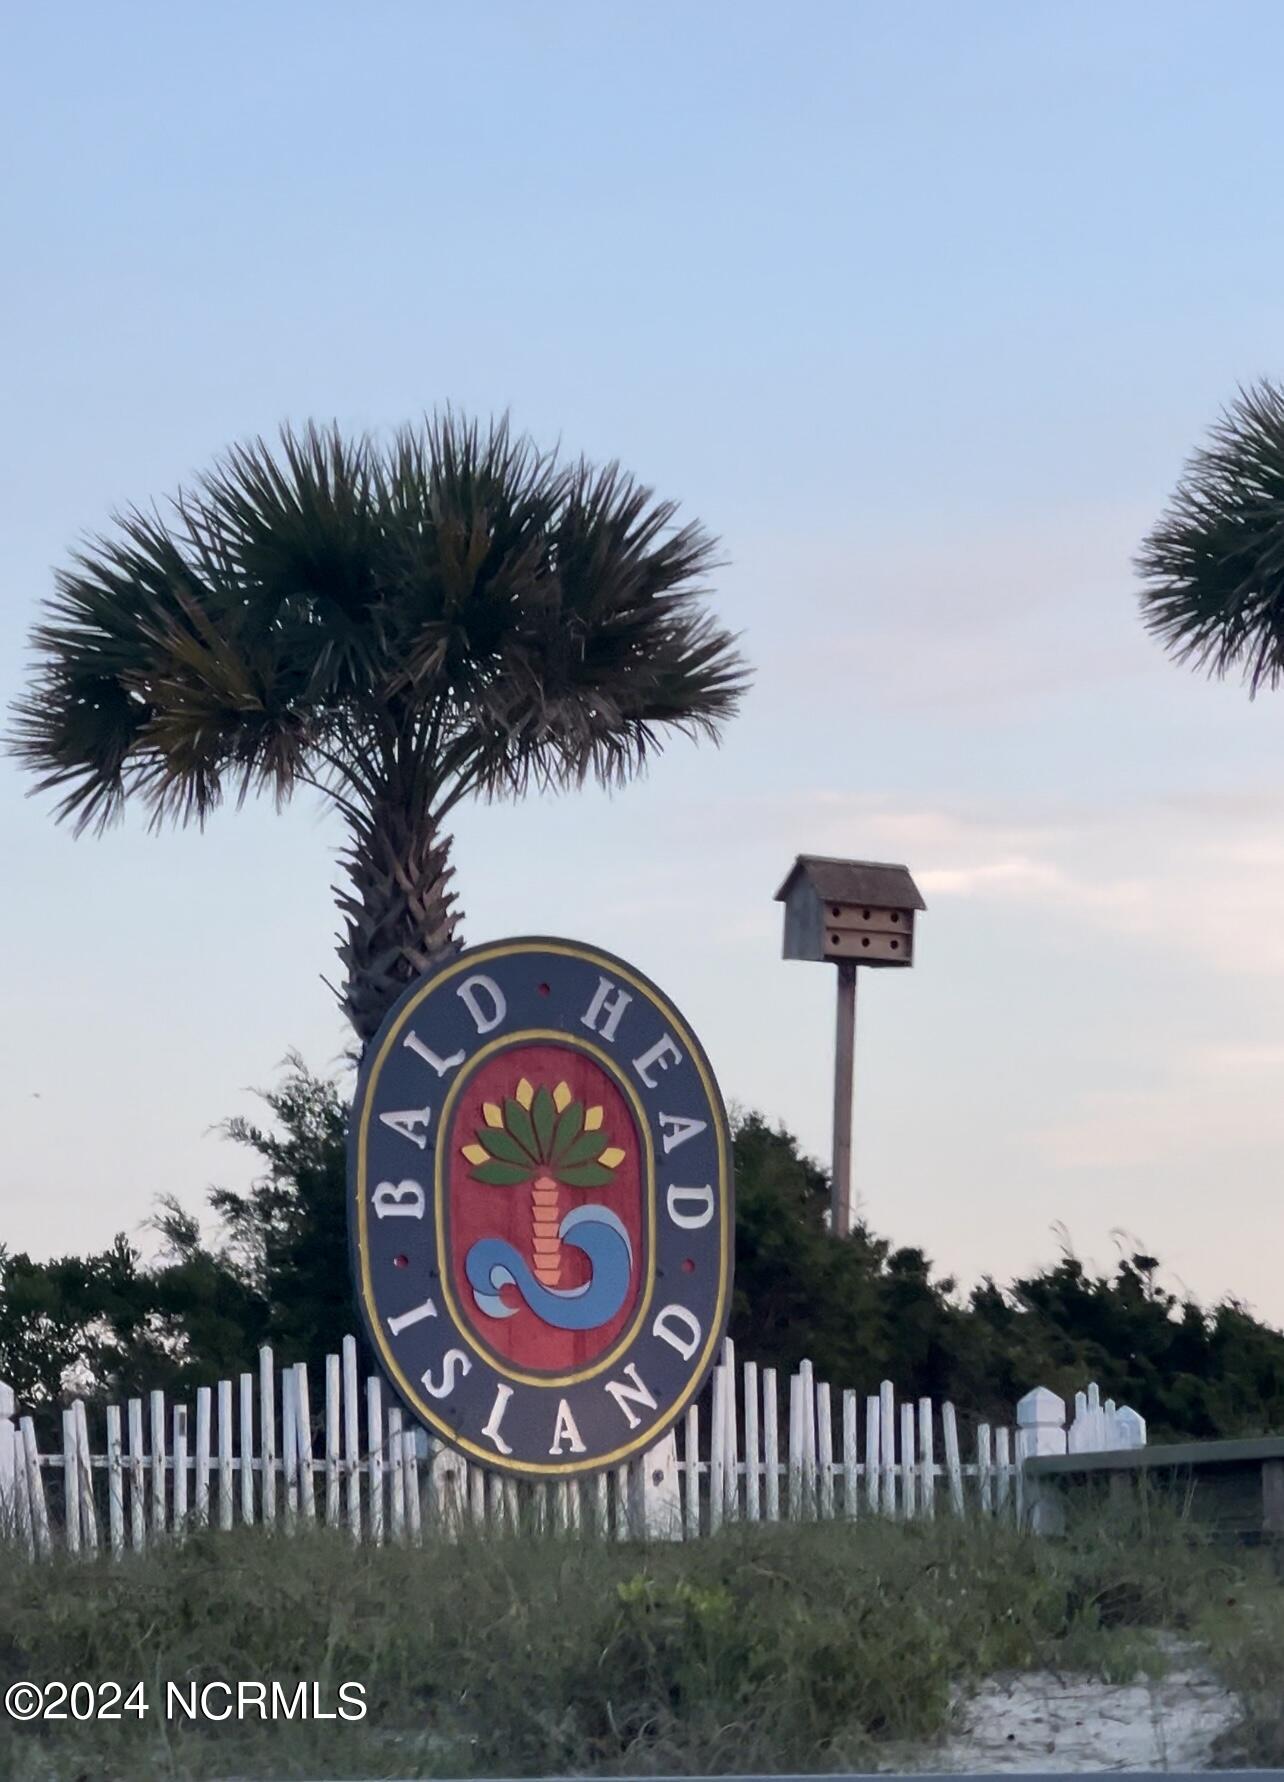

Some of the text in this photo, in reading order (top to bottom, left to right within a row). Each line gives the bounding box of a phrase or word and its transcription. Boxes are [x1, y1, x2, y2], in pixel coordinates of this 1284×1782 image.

[371, 974, 714, 1229] BALD HEAD
[387, 1298, 701, 1455] ISLAND
